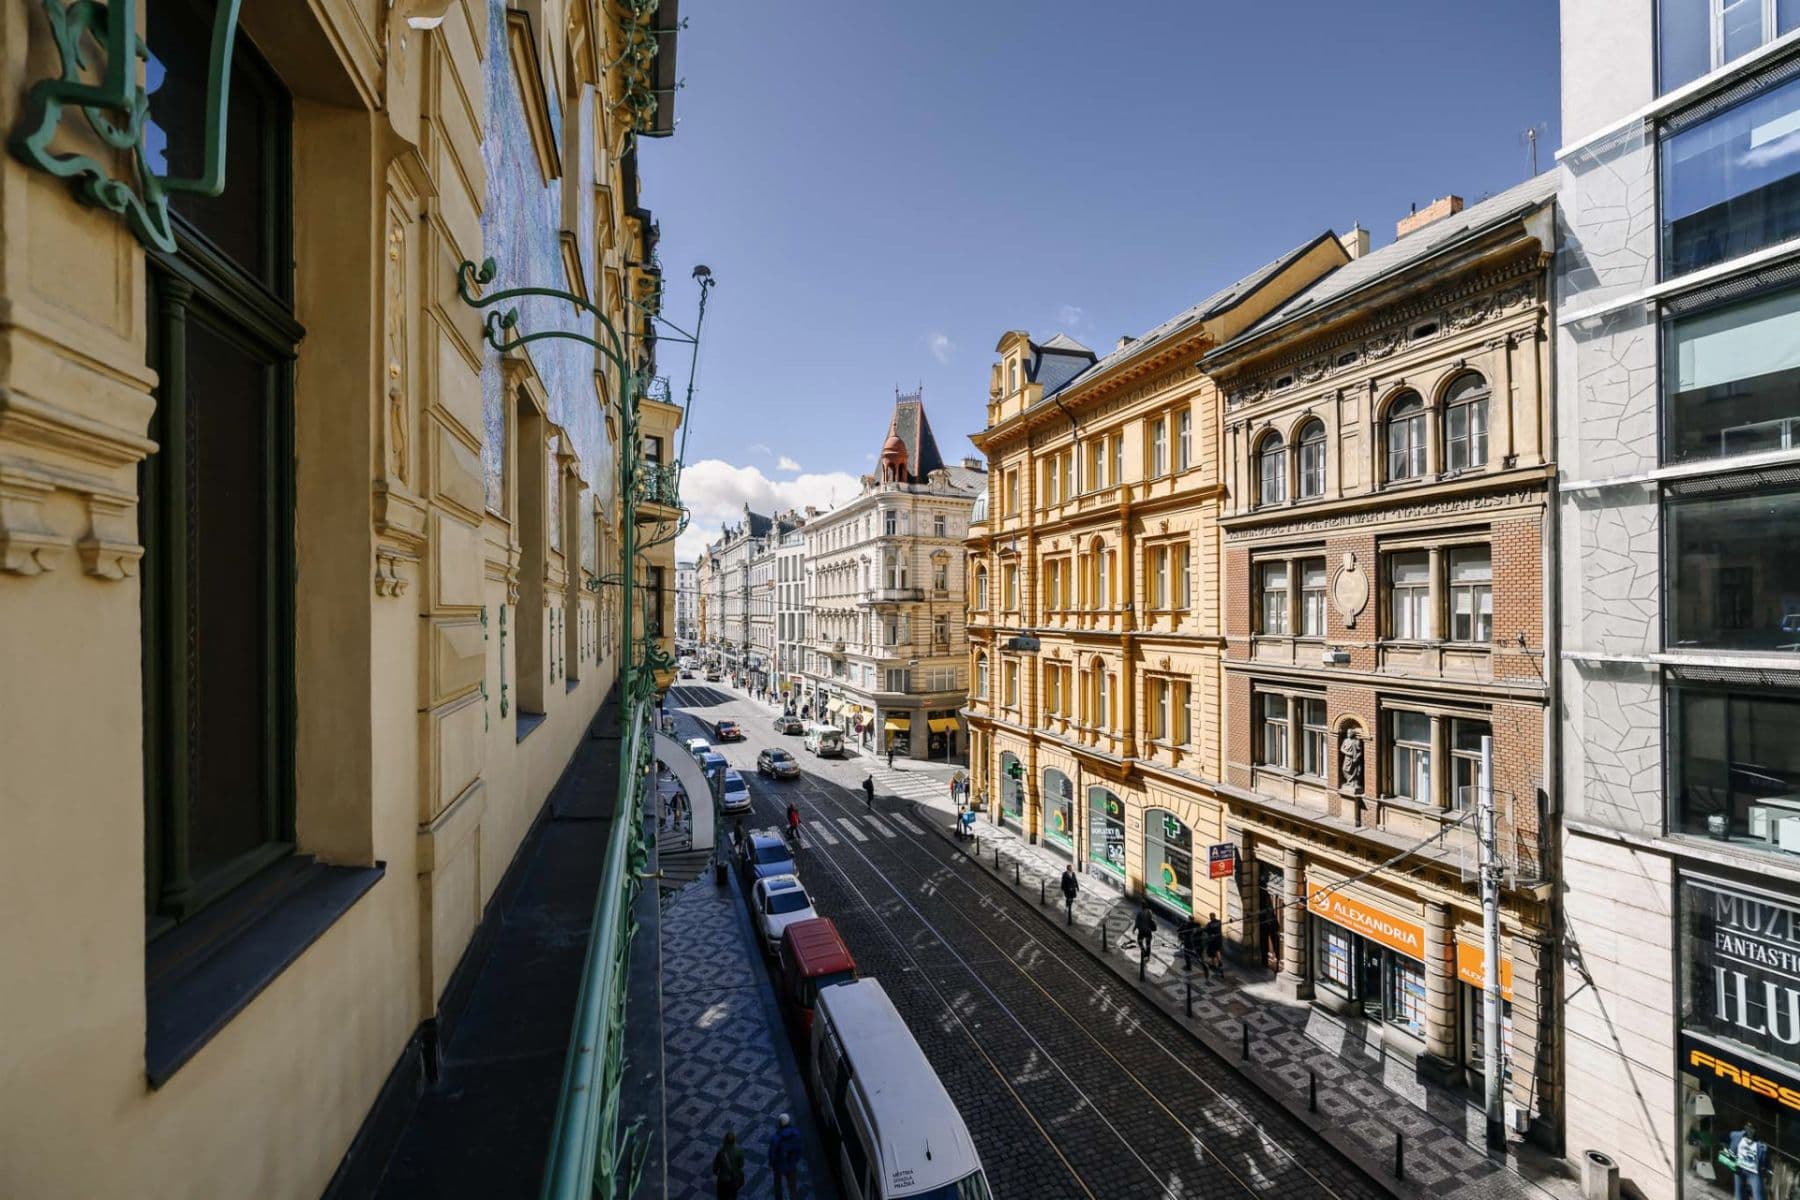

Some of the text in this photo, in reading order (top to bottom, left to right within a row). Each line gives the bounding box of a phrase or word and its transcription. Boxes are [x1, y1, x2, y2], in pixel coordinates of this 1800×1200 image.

[1334, 902, 1418, 947] ALEXANDRIA
[1715, 931, 1800, 974] FANTASTI
[1713, 964, 1800, 1046] ILU
